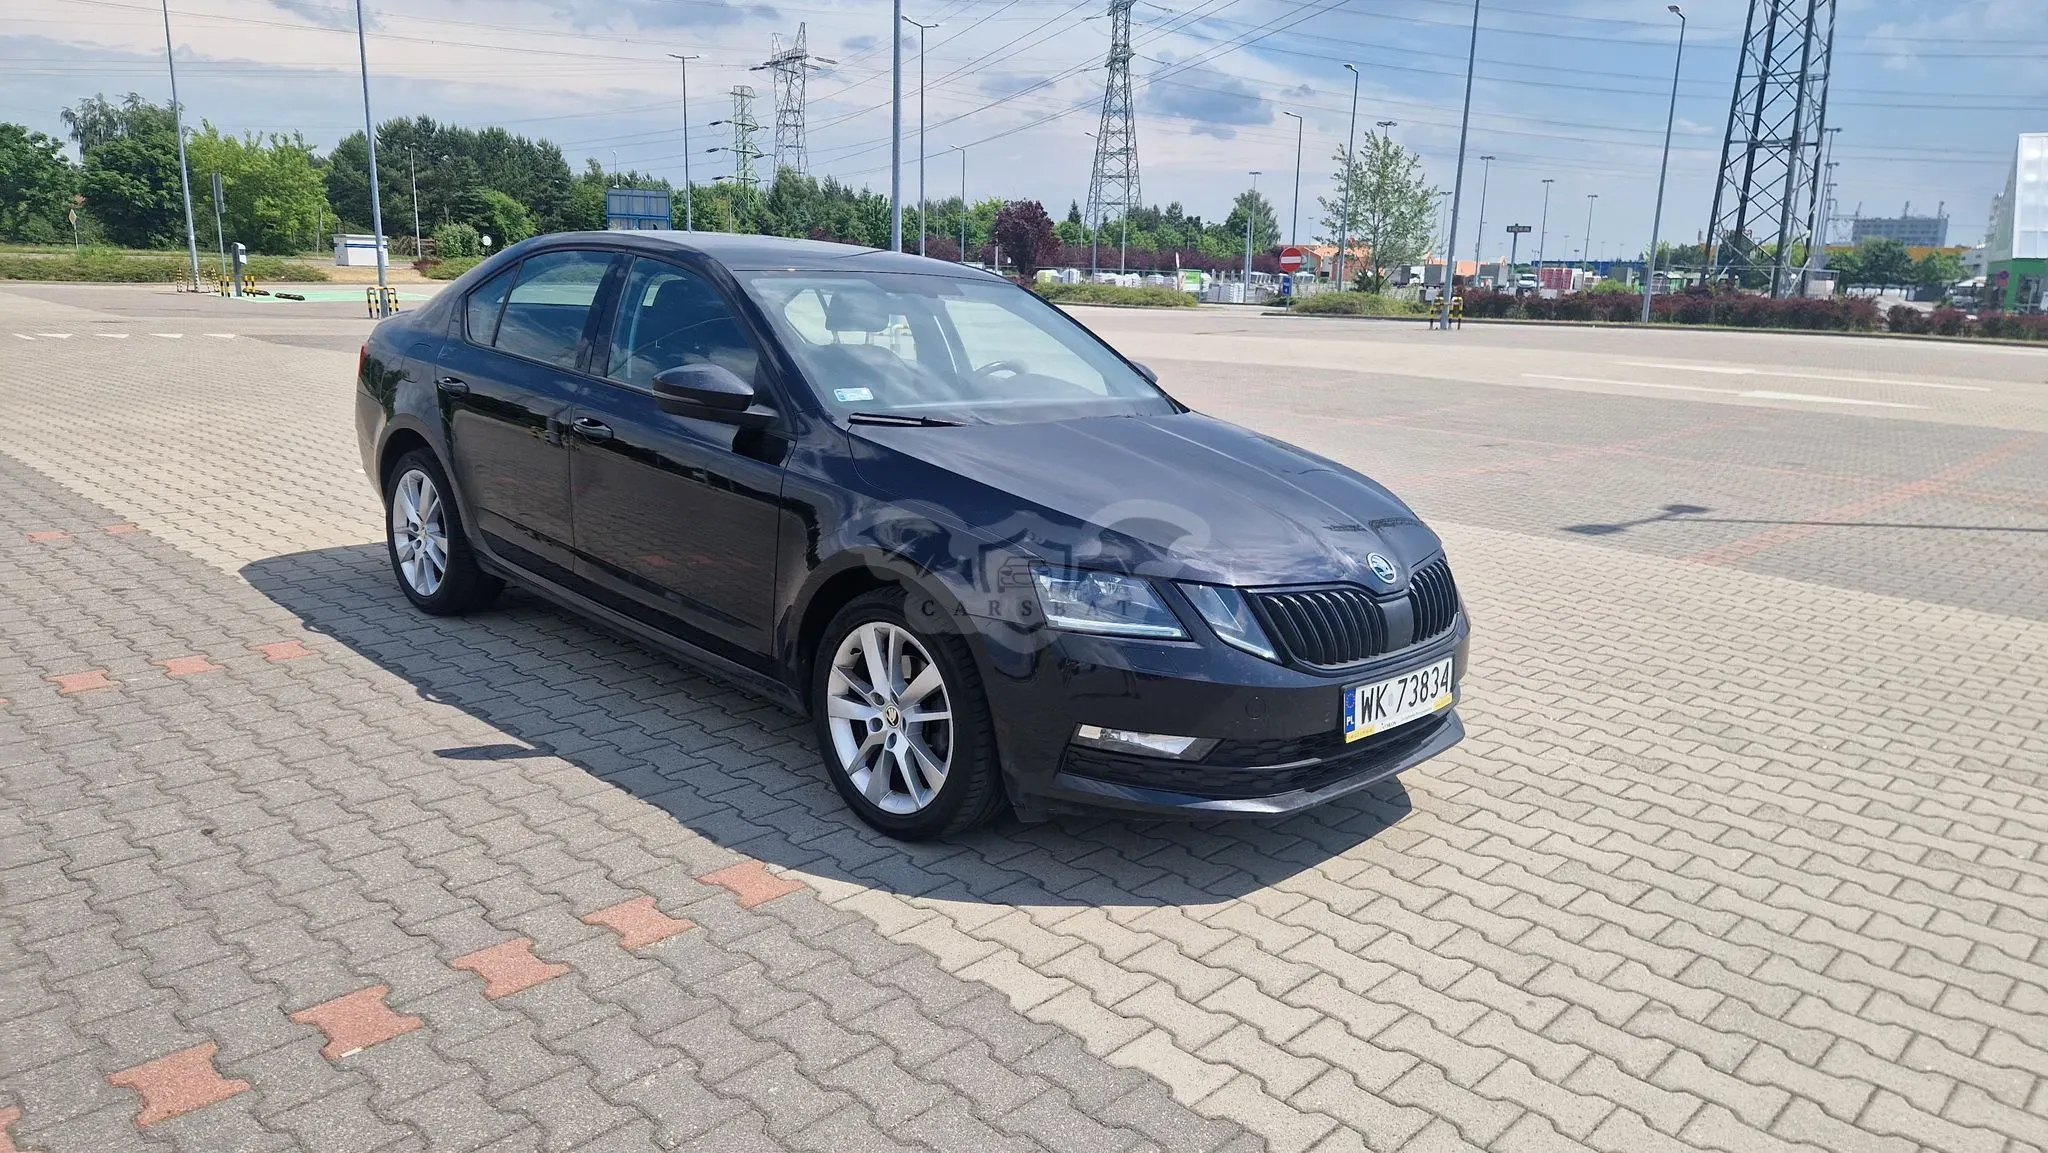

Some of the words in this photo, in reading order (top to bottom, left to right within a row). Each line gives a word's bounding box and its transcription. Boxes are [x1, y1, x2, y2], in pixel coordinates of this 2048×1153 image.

[1361, 683, 1389, 724] WK
[1396, 661, 1449, 713] 73834
[1346, 716, 1355, 726] PL
